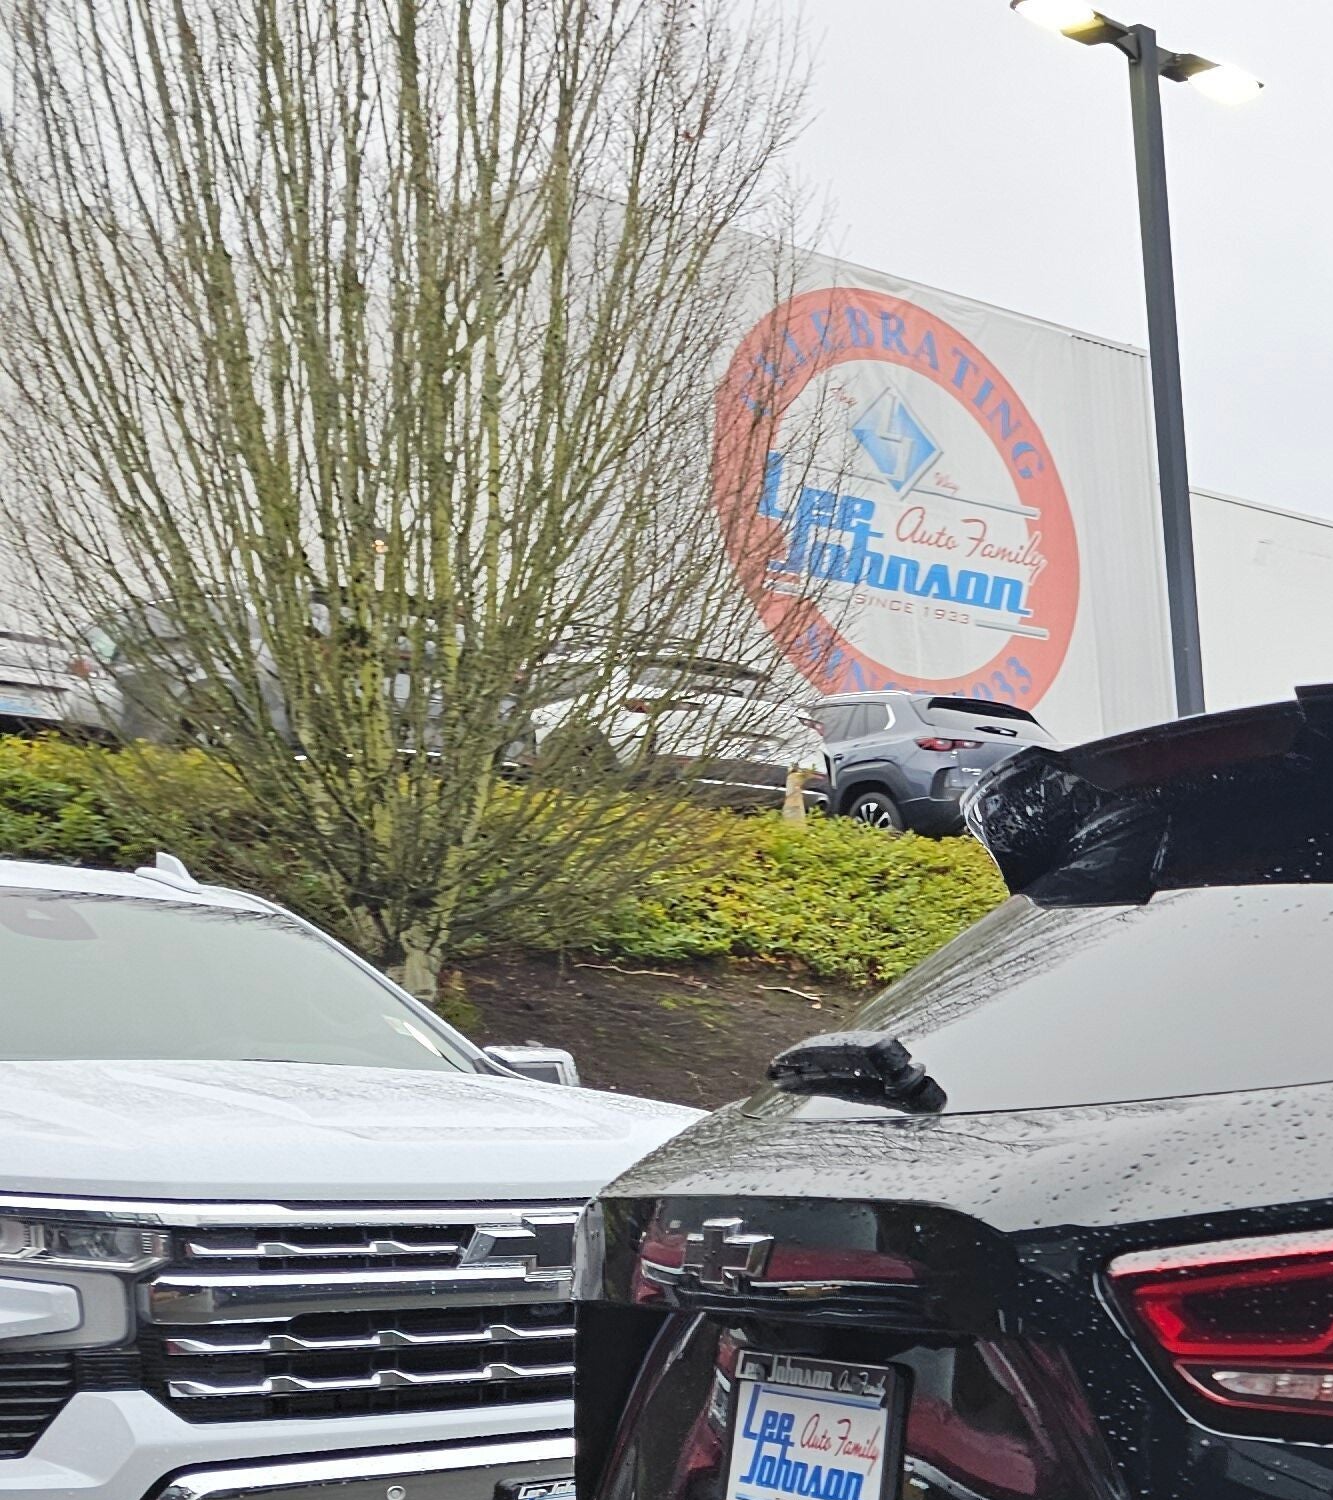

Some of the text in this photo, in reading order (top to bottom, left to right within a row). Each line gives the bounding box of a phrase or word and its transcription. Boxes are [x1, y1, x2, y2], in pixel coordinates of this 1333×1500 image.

[757, 449, 880, 532] Lee
[767, 521, 1032, 616] Johnson
[895, 506, 1046, 586] Auto Family
[854, 593, 971, 625] SINCE 1933
[952, 656, 1033, 704] 933
[767, 1354, 835, 1389] Johnson
[742, 1384, 796, 1444] Lee
[800, 1413, 881, 1477] Auto Family
